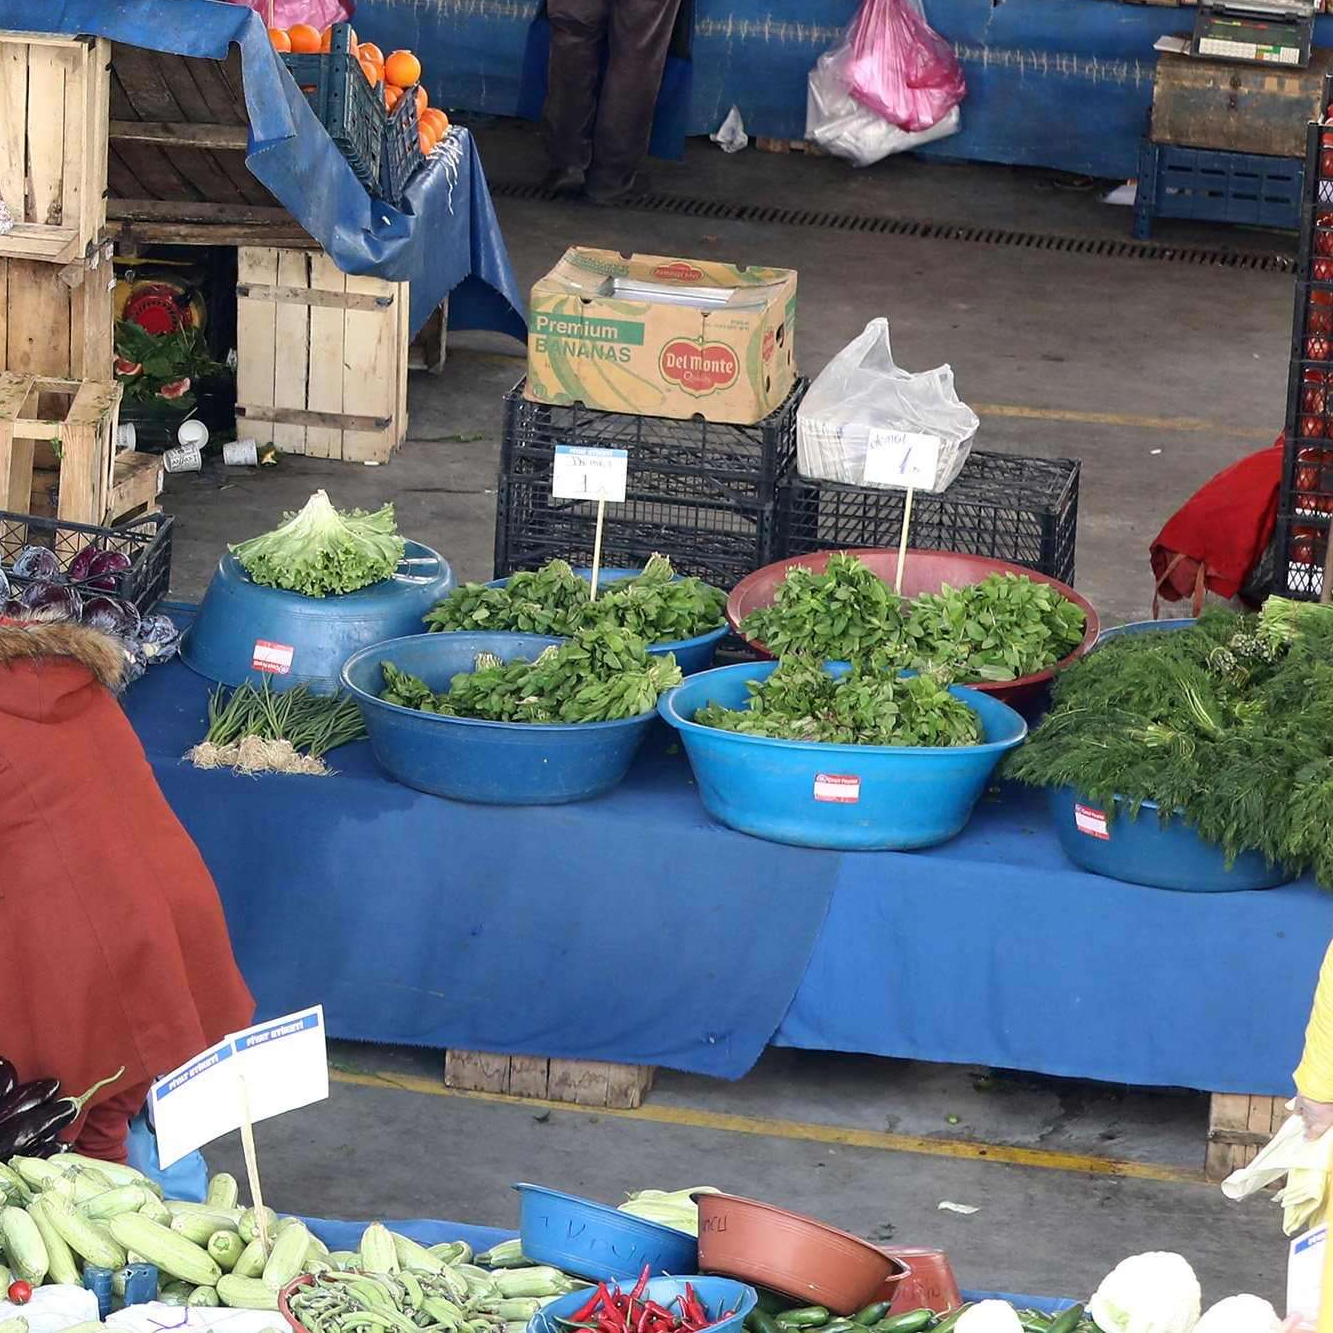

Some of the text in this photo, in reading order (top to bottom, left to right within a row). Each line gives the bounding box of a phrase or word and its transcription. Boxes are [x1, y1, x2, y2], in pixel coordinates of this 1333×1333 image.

[536, 316, 618, 339] Premium
[535, 337, 631, 363] BANANAS
[665, 353, 733, 375] Del Monte
